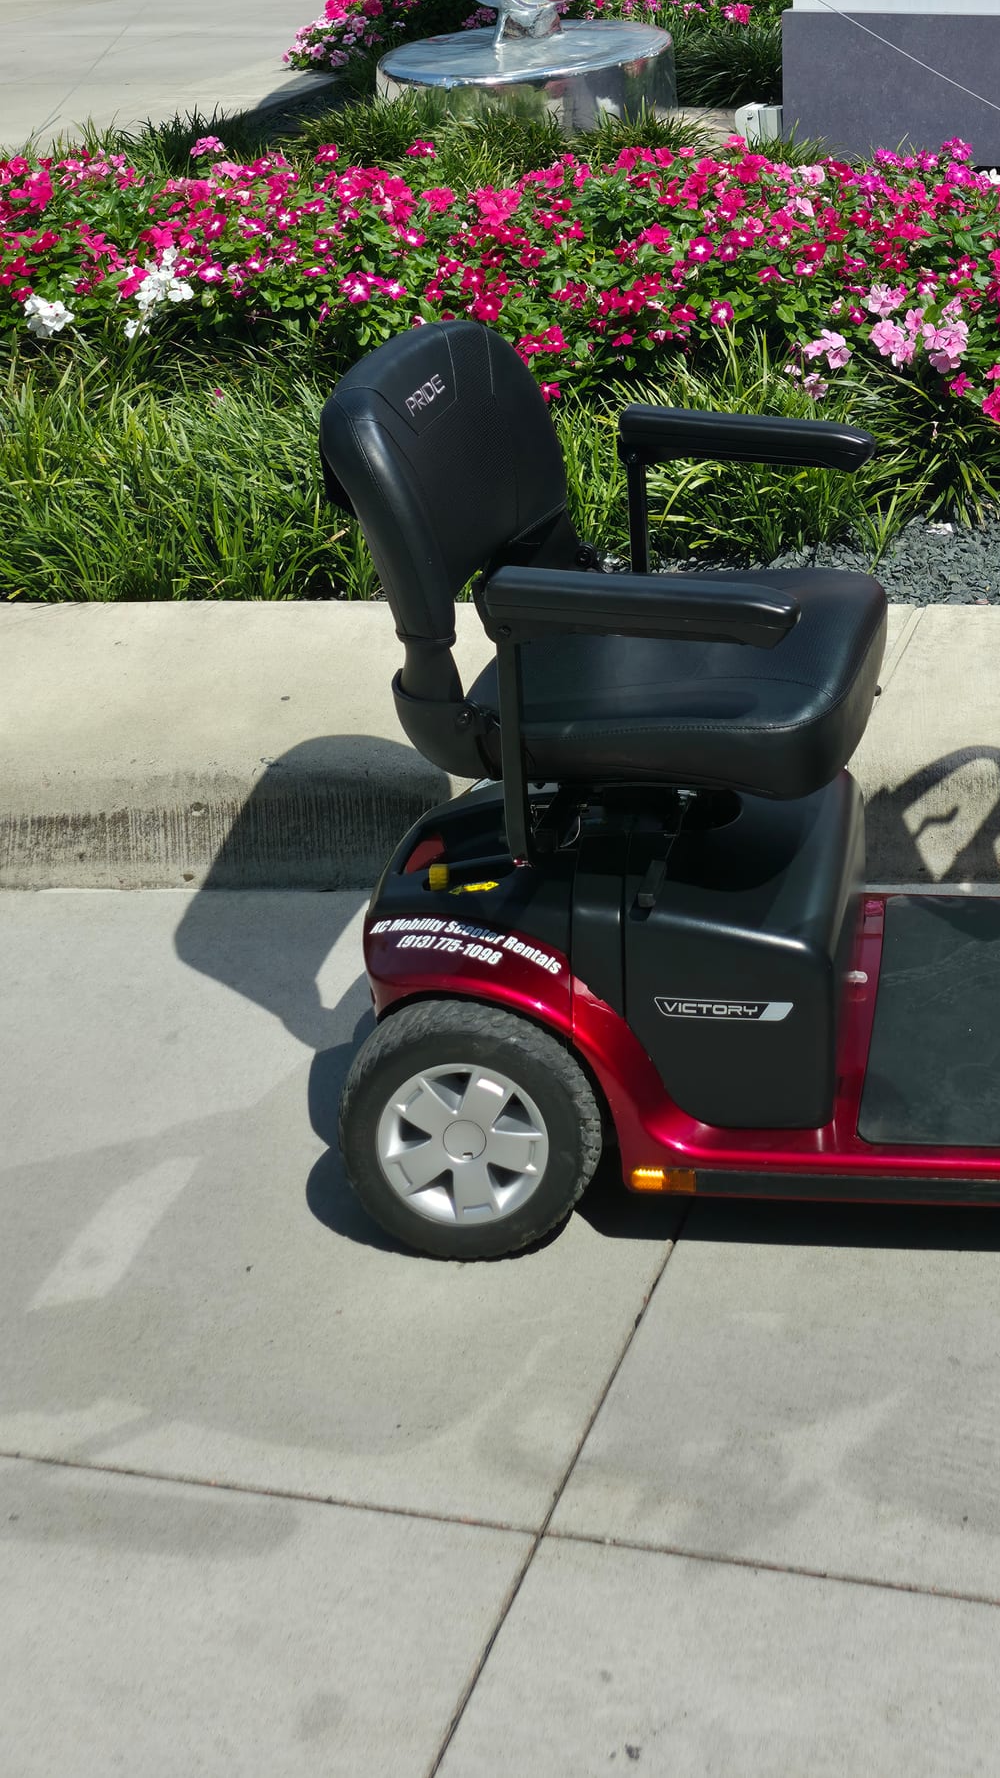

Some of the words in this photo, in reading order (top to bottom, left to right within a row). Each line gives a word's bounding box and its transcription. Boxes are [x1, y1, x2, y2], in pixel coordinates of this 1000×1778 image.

[404, 373, 446, 418] PRIDE
[369, 920, 391, 935] KC
[388, 918, 447, 935] Mobility
[444, 920, 506, 944] Scooter
[502, 936, 562, 975] Rentals
[396, 935, 437, 949] (913)
[433, 937, 504, 966] 775-1098
[663, 1001, 758, 1016] VICTORY
